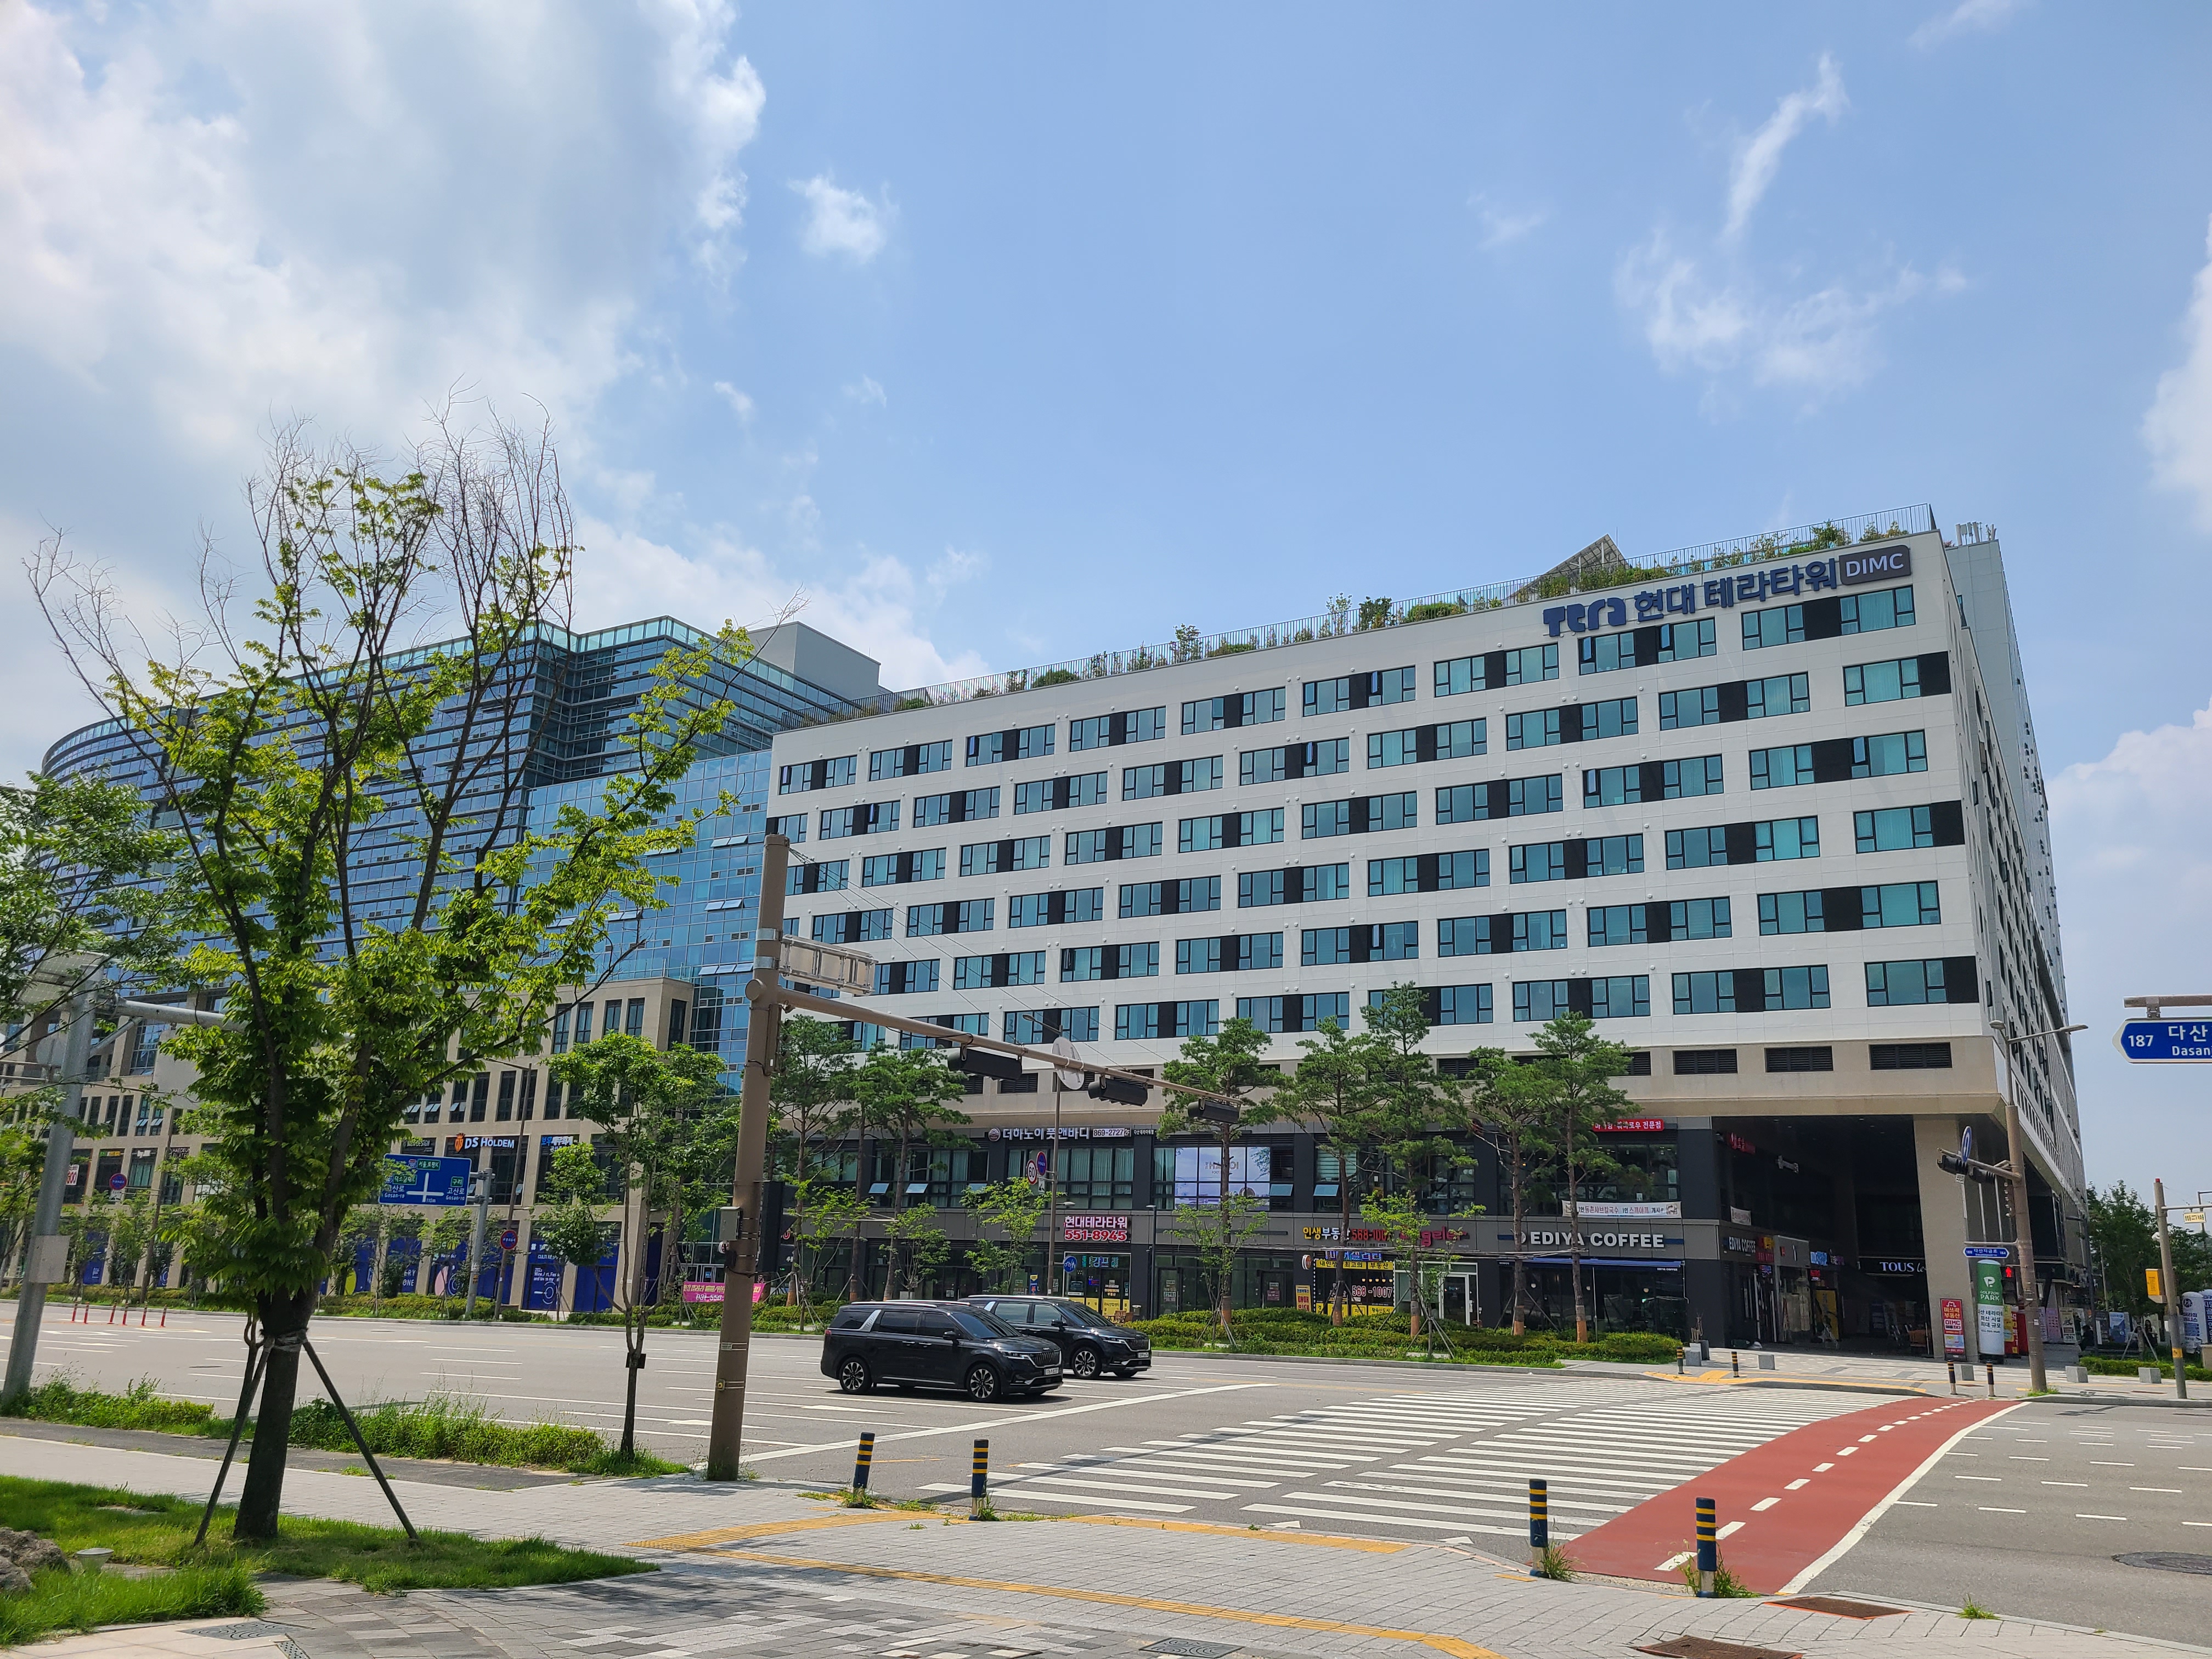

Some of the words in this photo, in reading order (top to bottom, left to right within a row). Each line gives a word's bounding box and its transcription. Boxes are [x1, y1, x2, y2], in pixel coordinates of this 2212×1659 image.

[1634, 583, 1696, 622] 현대
[1704, 558, 1837, 608] 테라타워
[1846, 552, 1905, 578] DIMC
[2168, 1025, 2212, 1042] 다산
[2128, 1035, 2153, 1047] 187
[1643, 1121, 1661, 1129] 전문점
[1002, 1128, 1045, 1140] 더하노이
[1046, 1127, 1090, 1139] 풋앤바디
[464, 1137, 478, 1149] DS
[1029, 1166, 1035, 1178] 60
[447, 1187, 465, 1195] 고산로
[1064, 1216, 1127, 1228] 현대테라타워
[1064, 1229, 1127, 1242] 551-8945
[1351, 1228, 1390, 1241] 568-100
[1530, 1231, 1585, 1245] EDIYA
[1590, 1233, 1664, 1248] COFFEE
[1729, 1236, 1741, 1251] EDIYA
[1741, 1238, 1756, 1253] COFFEE
[1880, 1262, 1915, 1272] TOUS
[1352, 1285, 1393, 1298] 568-1007
